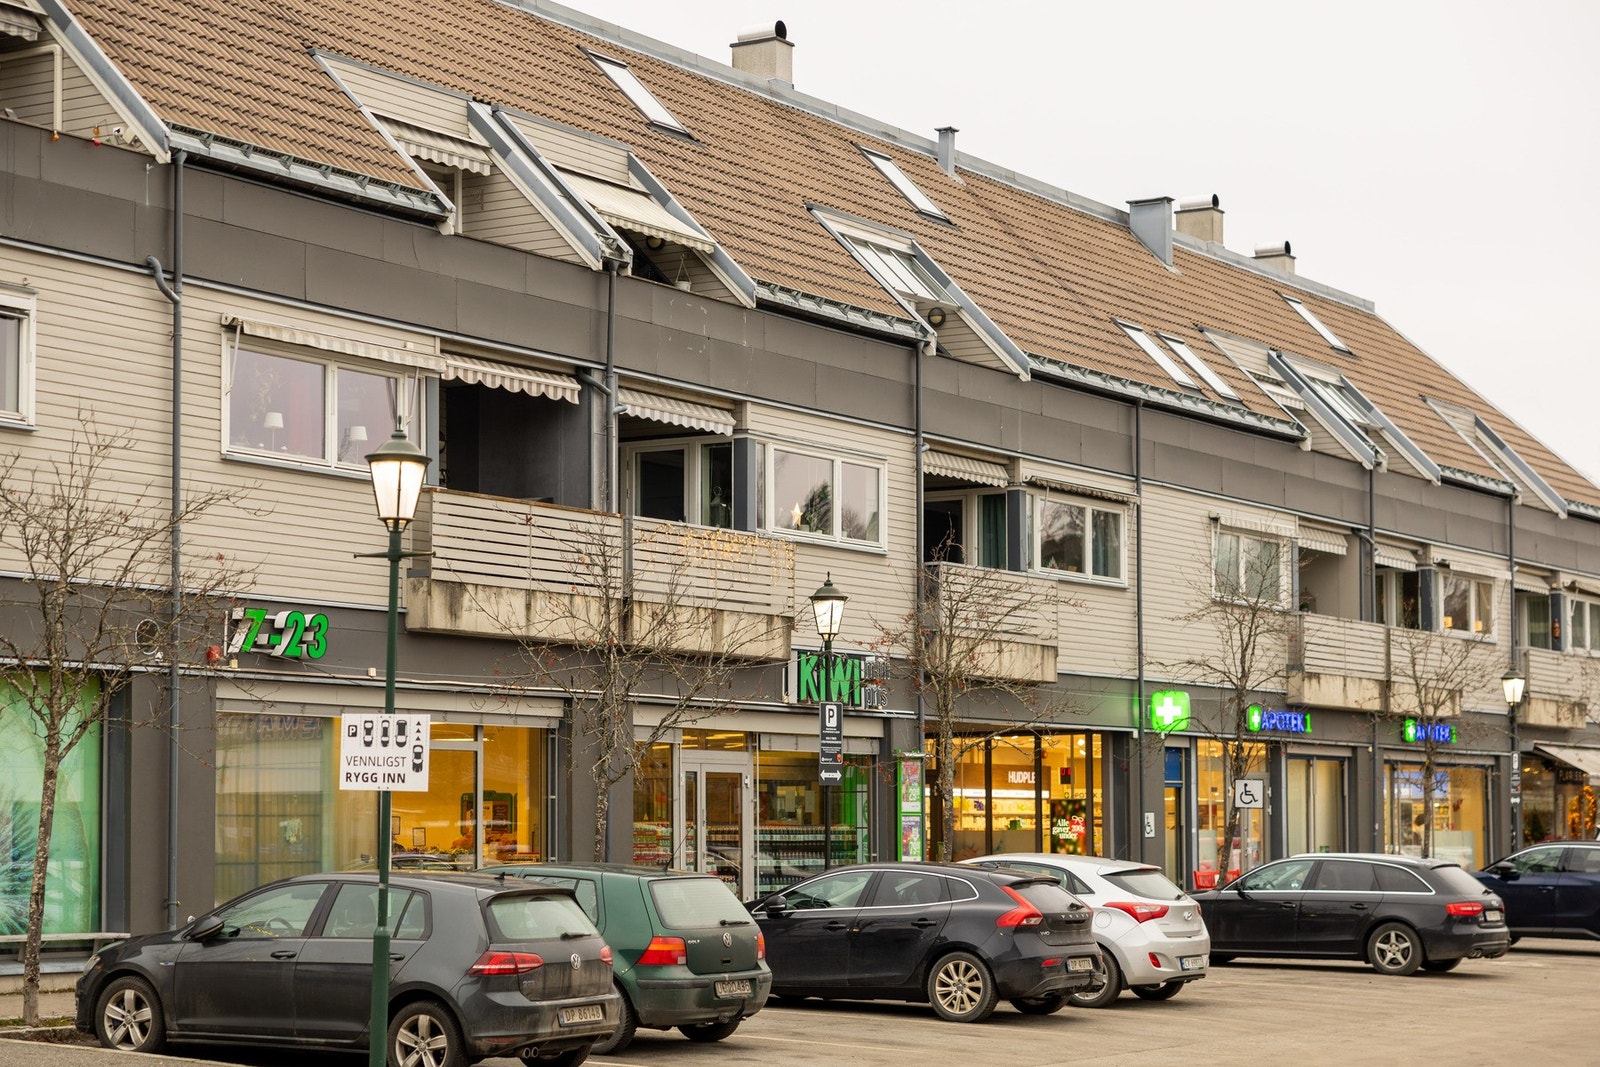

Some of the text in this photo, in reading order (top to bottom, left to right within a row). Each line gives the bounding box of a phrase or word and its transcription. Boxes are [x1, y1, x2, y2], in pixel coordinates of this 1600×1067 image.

[241, 607, 329, 659] 7-23
[800, 652, 862, 706] KIWI
[1261, 709, 1312, 733] APOTEK 1
[345, 755, 407, 767] VENNLIGST
[345, 772, 406, 784] RYGG INN
[1056, 818, 1070, 827] Alle
[564, 1006, 601, 1022] DP 86148
